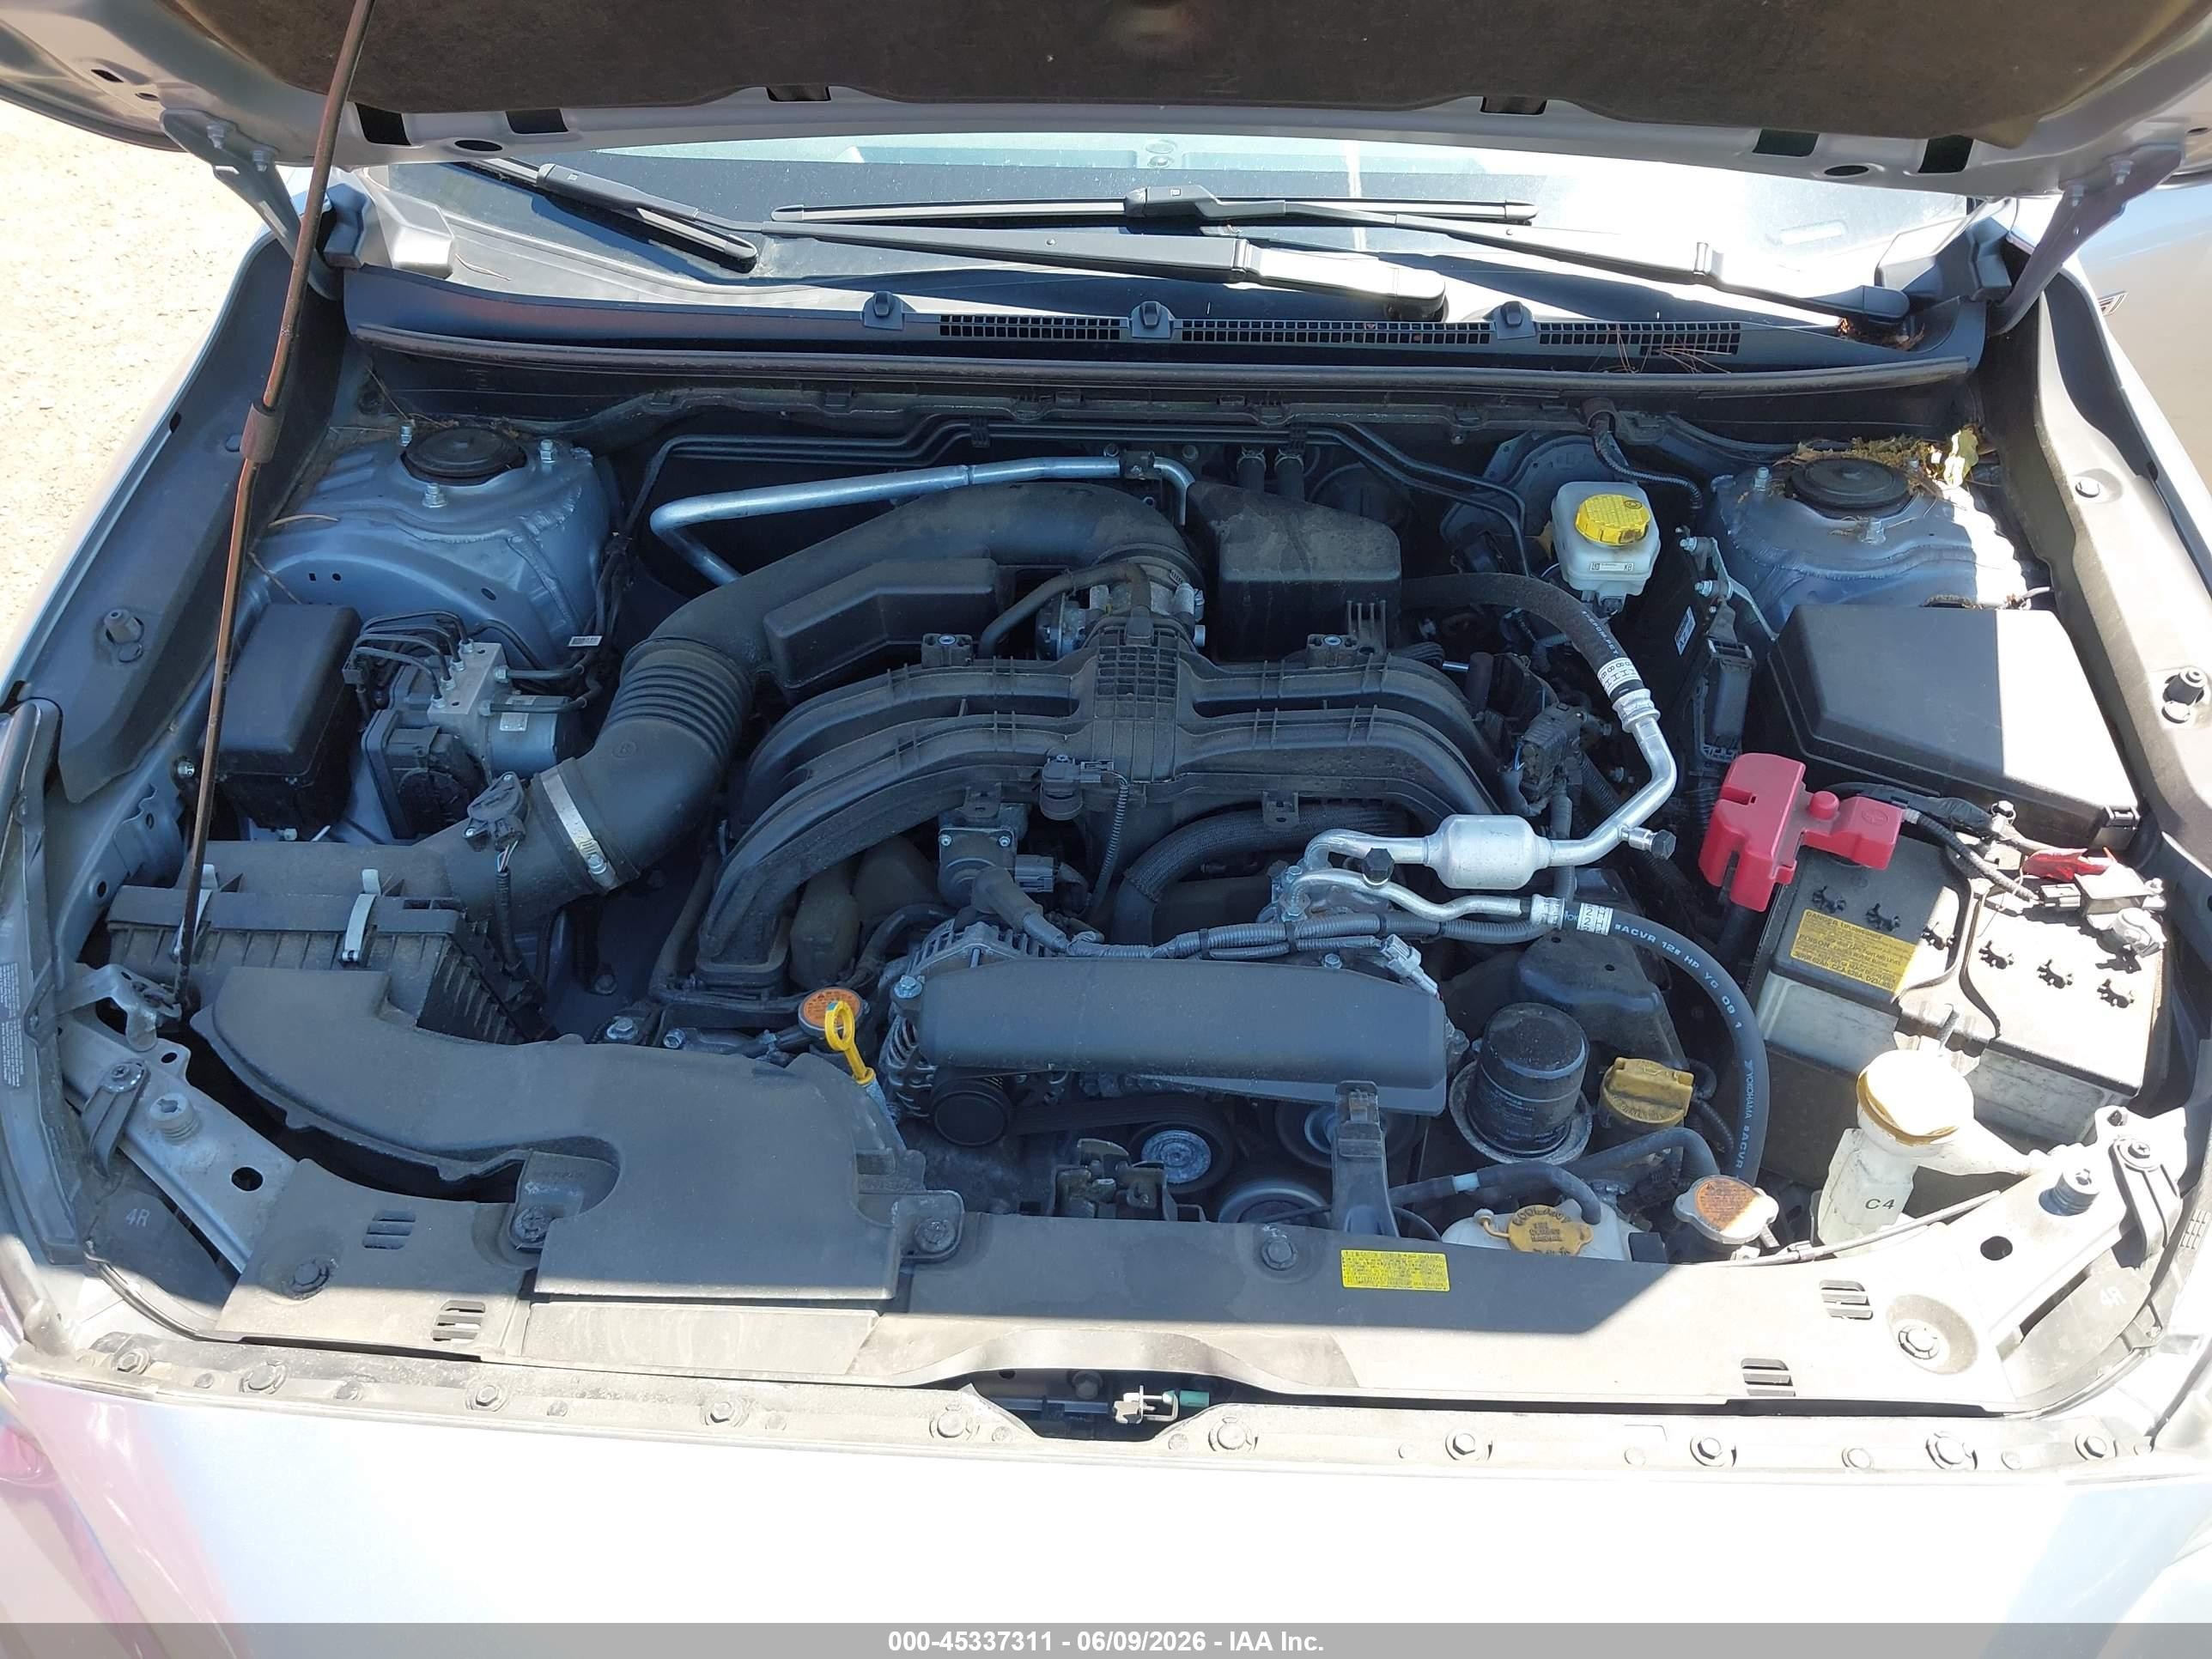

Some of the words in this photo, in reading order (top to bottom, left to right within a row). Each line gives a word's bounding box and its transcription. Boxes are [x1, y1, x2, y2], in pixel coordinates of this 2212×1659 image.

[1798, 933, 1830, 948] POISON
[1683, 955, 1700, 969] HP
[1745, 1072, 1753, 1119] YOKOHAMA
[1865, 1199, 1895, 1210] C4
[125, 1208, 151, 1227] 4R
